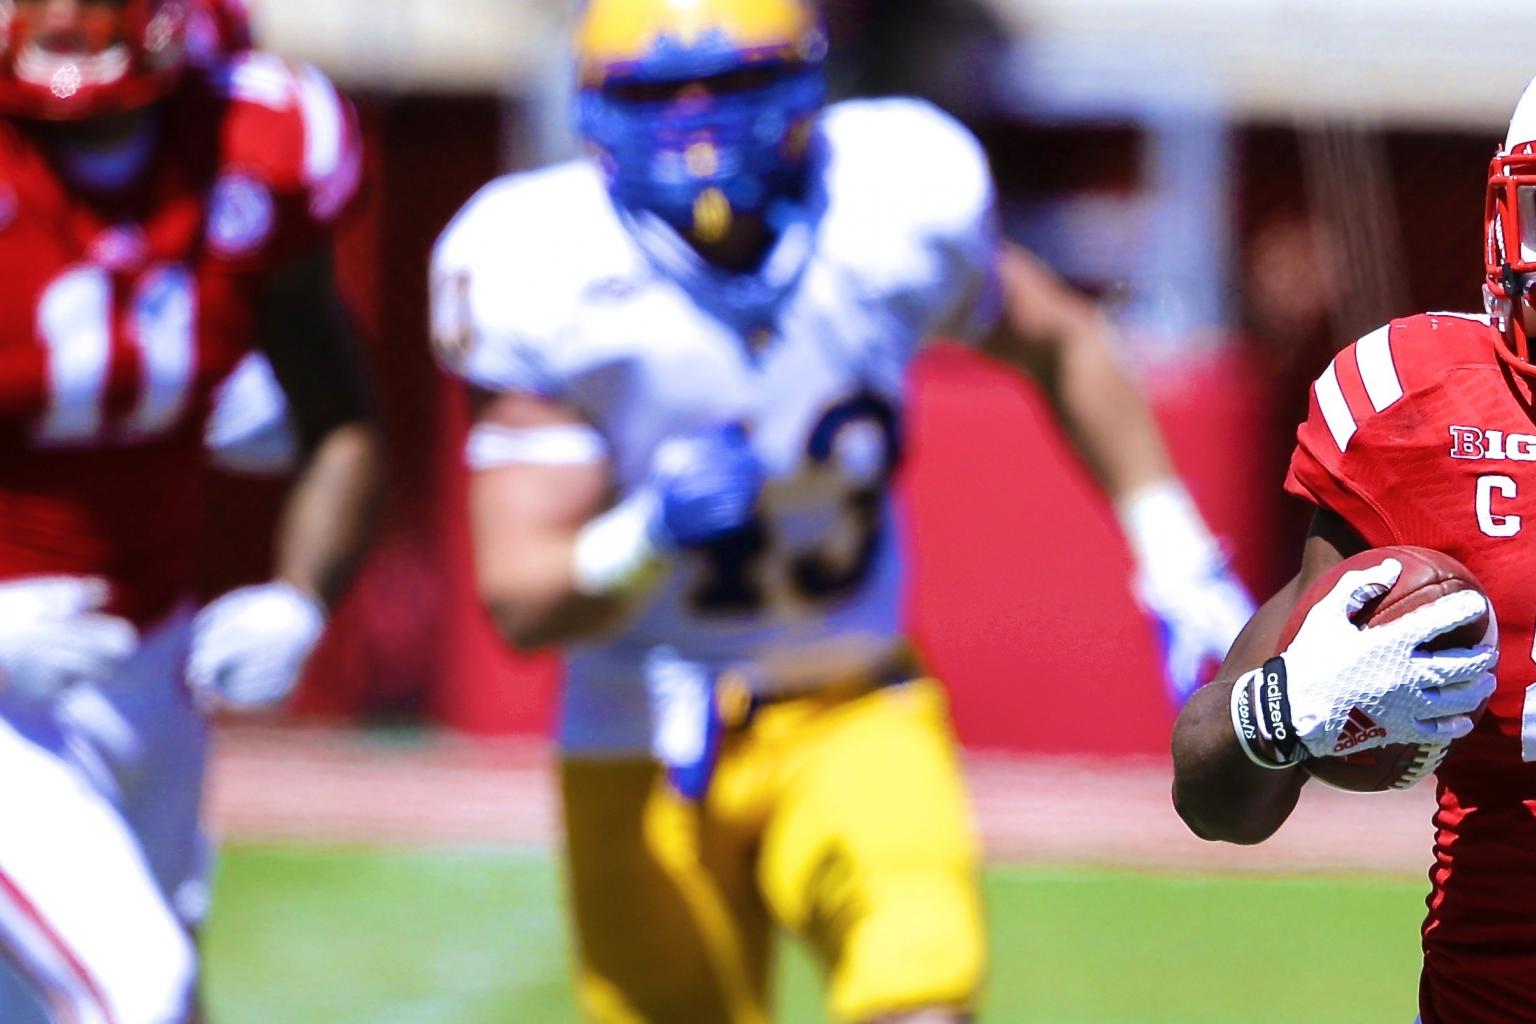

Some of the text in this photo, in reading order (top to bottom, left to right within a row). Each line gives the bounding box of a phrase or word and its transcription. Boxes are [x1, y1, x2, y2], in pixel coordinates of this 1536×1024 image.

[36, 263, 197, 442] 11
[1475, 474, 1522, 538] C
[1266, 672, 1287, 740] adizero
